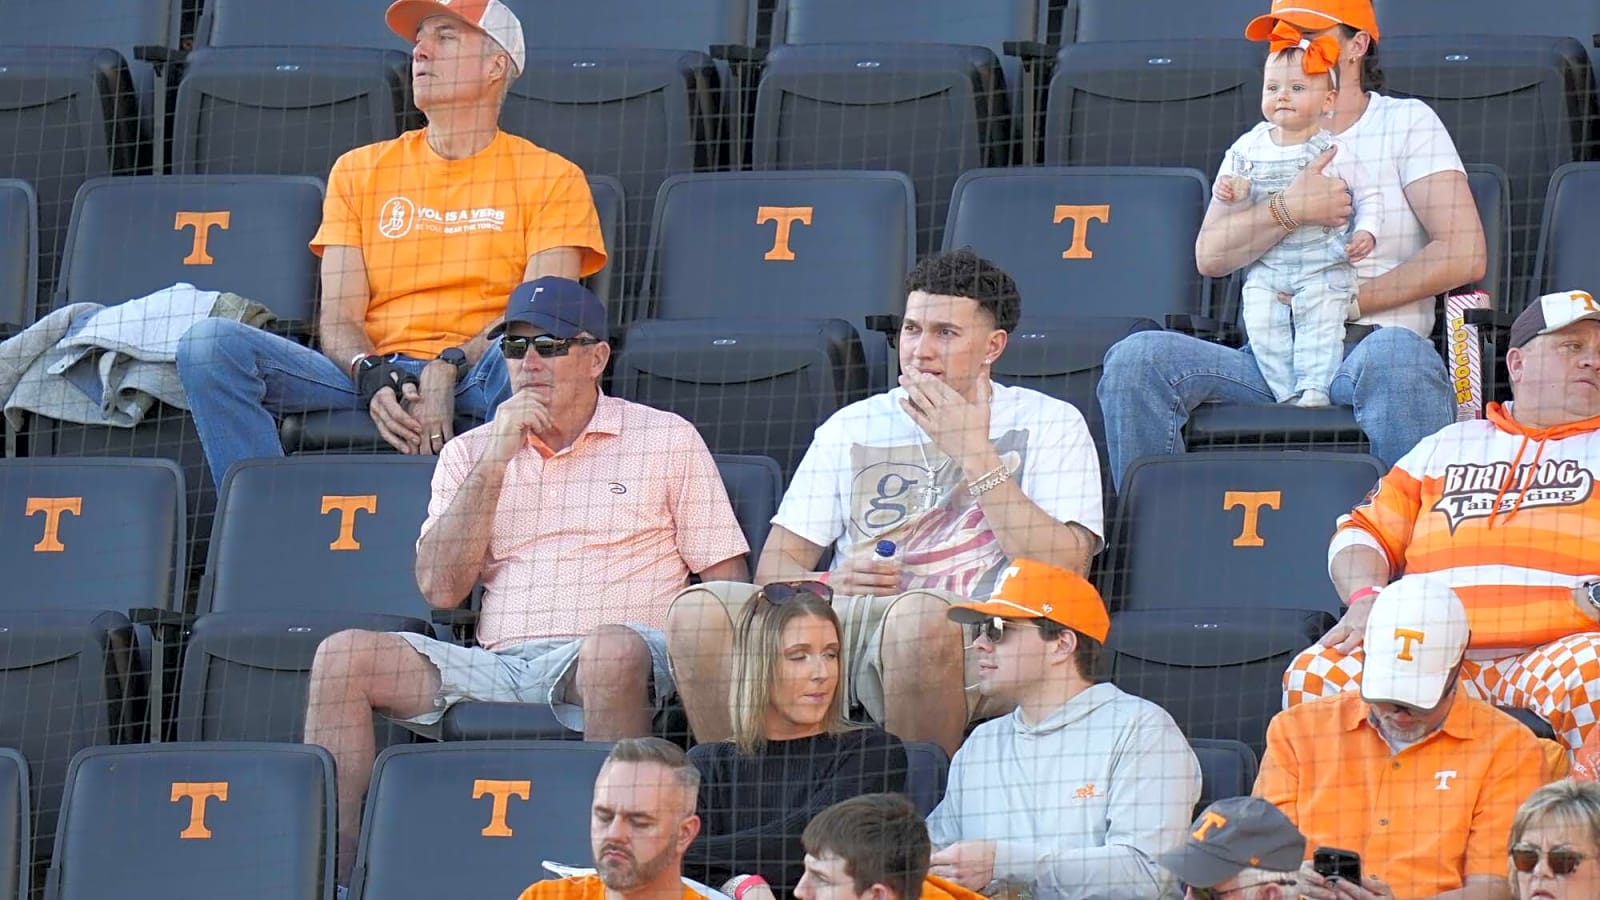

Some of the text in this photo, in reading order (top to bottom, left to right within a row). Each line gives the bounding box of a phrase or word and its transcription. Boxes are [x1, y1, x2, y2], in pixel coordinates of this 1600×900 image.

[176, 211, 230, 265] T
[445, 211, 458, 222] IS
[459, 210, 468, 220] A
[471, 208, 505, 220] VERB
[758, 207, 813, 260] T
[1055, 205, 1109, 259] T
[1452, 317, 1473, 405] POPCORN
[1444, 460, 1579, 495] BIRD DOG
[27, 498, 81, 552] T
[321, 496, 377, 550] T
[1224, 491, 1281, 547] T
[1394, 628, 1425, 662] T
[1435, 770, 1457, 790] T
[171, 782, 228, 839] T
[473, 780, 531, 837] T
[1192, 811, 1227, 842] T
